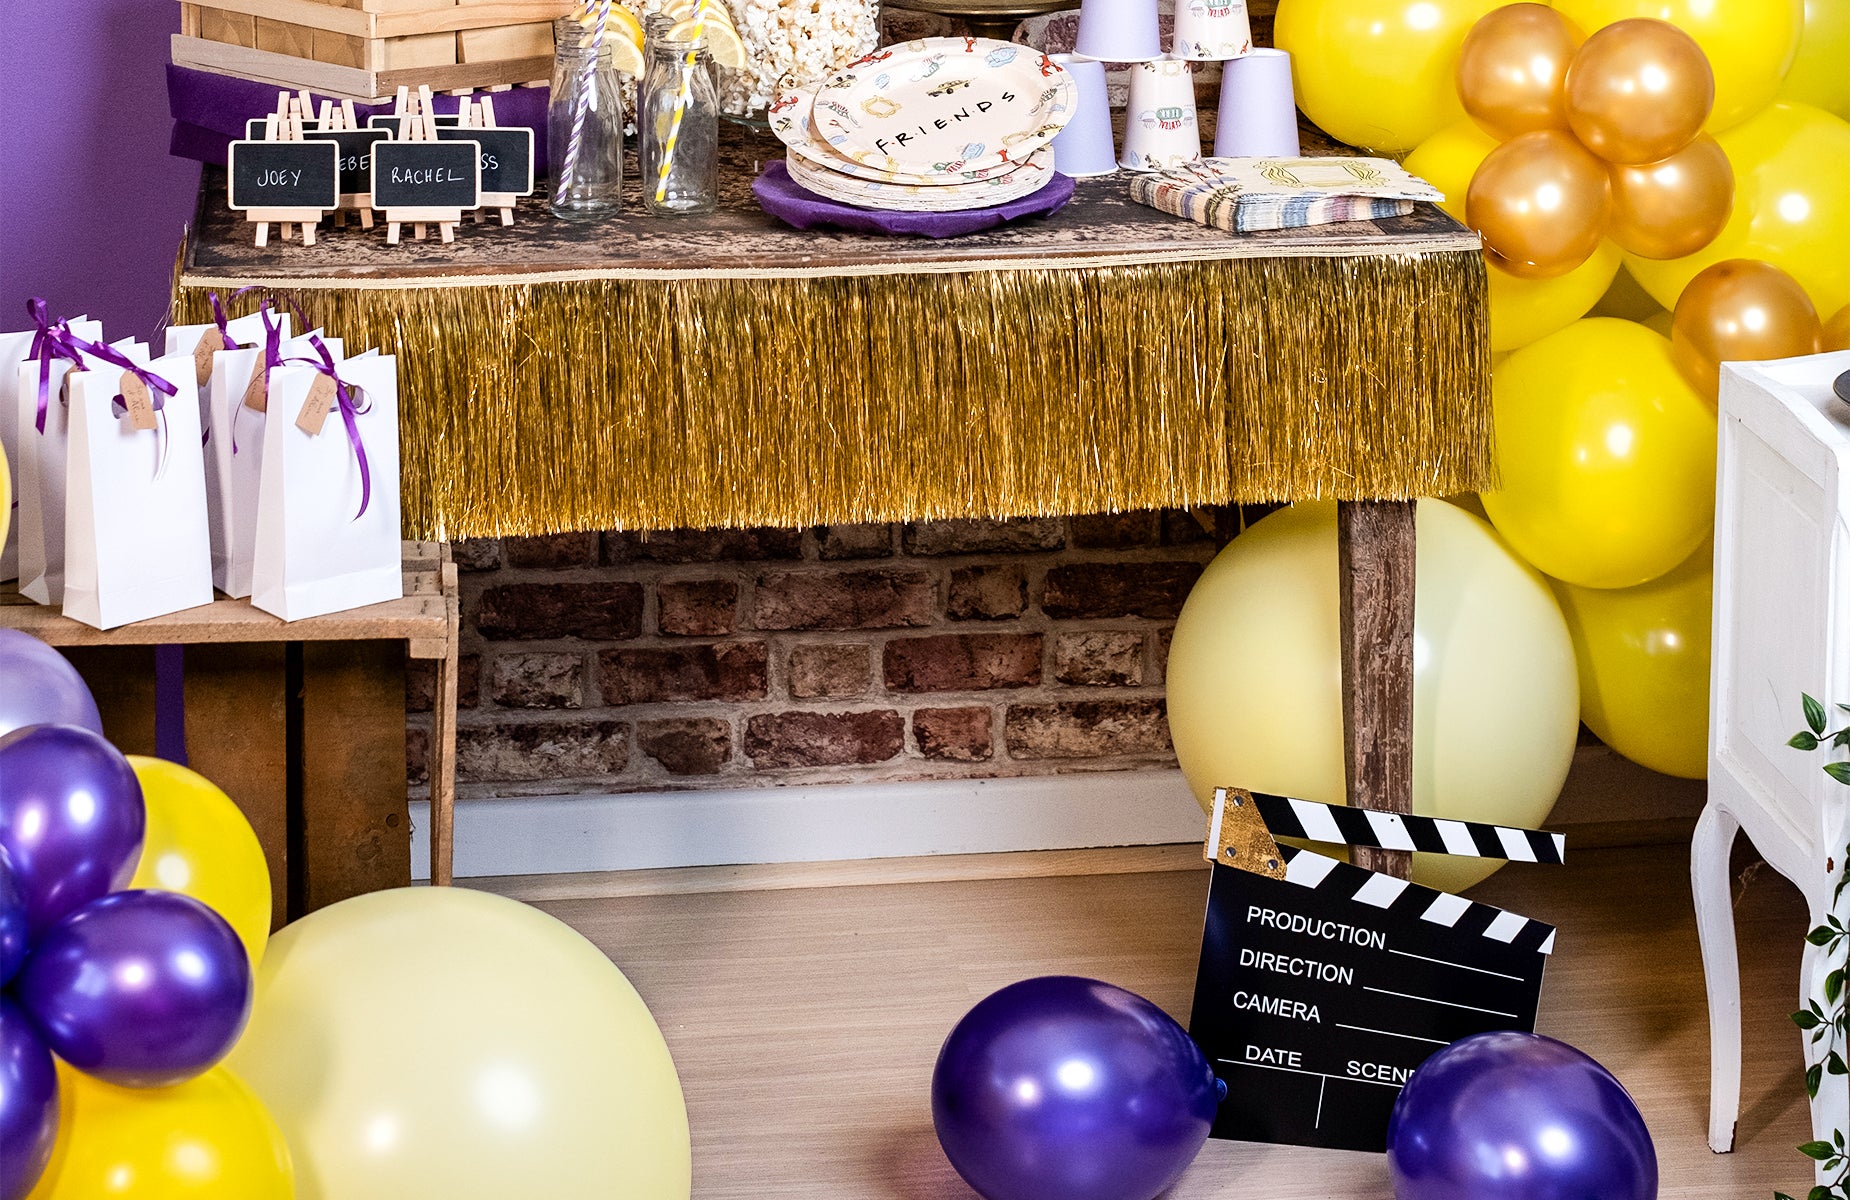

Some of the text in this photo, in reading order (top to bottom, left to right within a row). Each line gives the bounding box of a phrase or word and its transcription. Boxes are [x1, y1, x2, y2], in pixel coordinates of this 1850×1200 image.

[256, 168, 302, 187] JOEY
[391, 166, 465, 185] RACHEL
[1246, 905, 1386, 950] PRODUCTION
[1239, 948, 1354, 986] DIRECTION
[1233, 991, 1321, 1024] CAMERA
[1245, 1044, 1303, 1068] DATE
